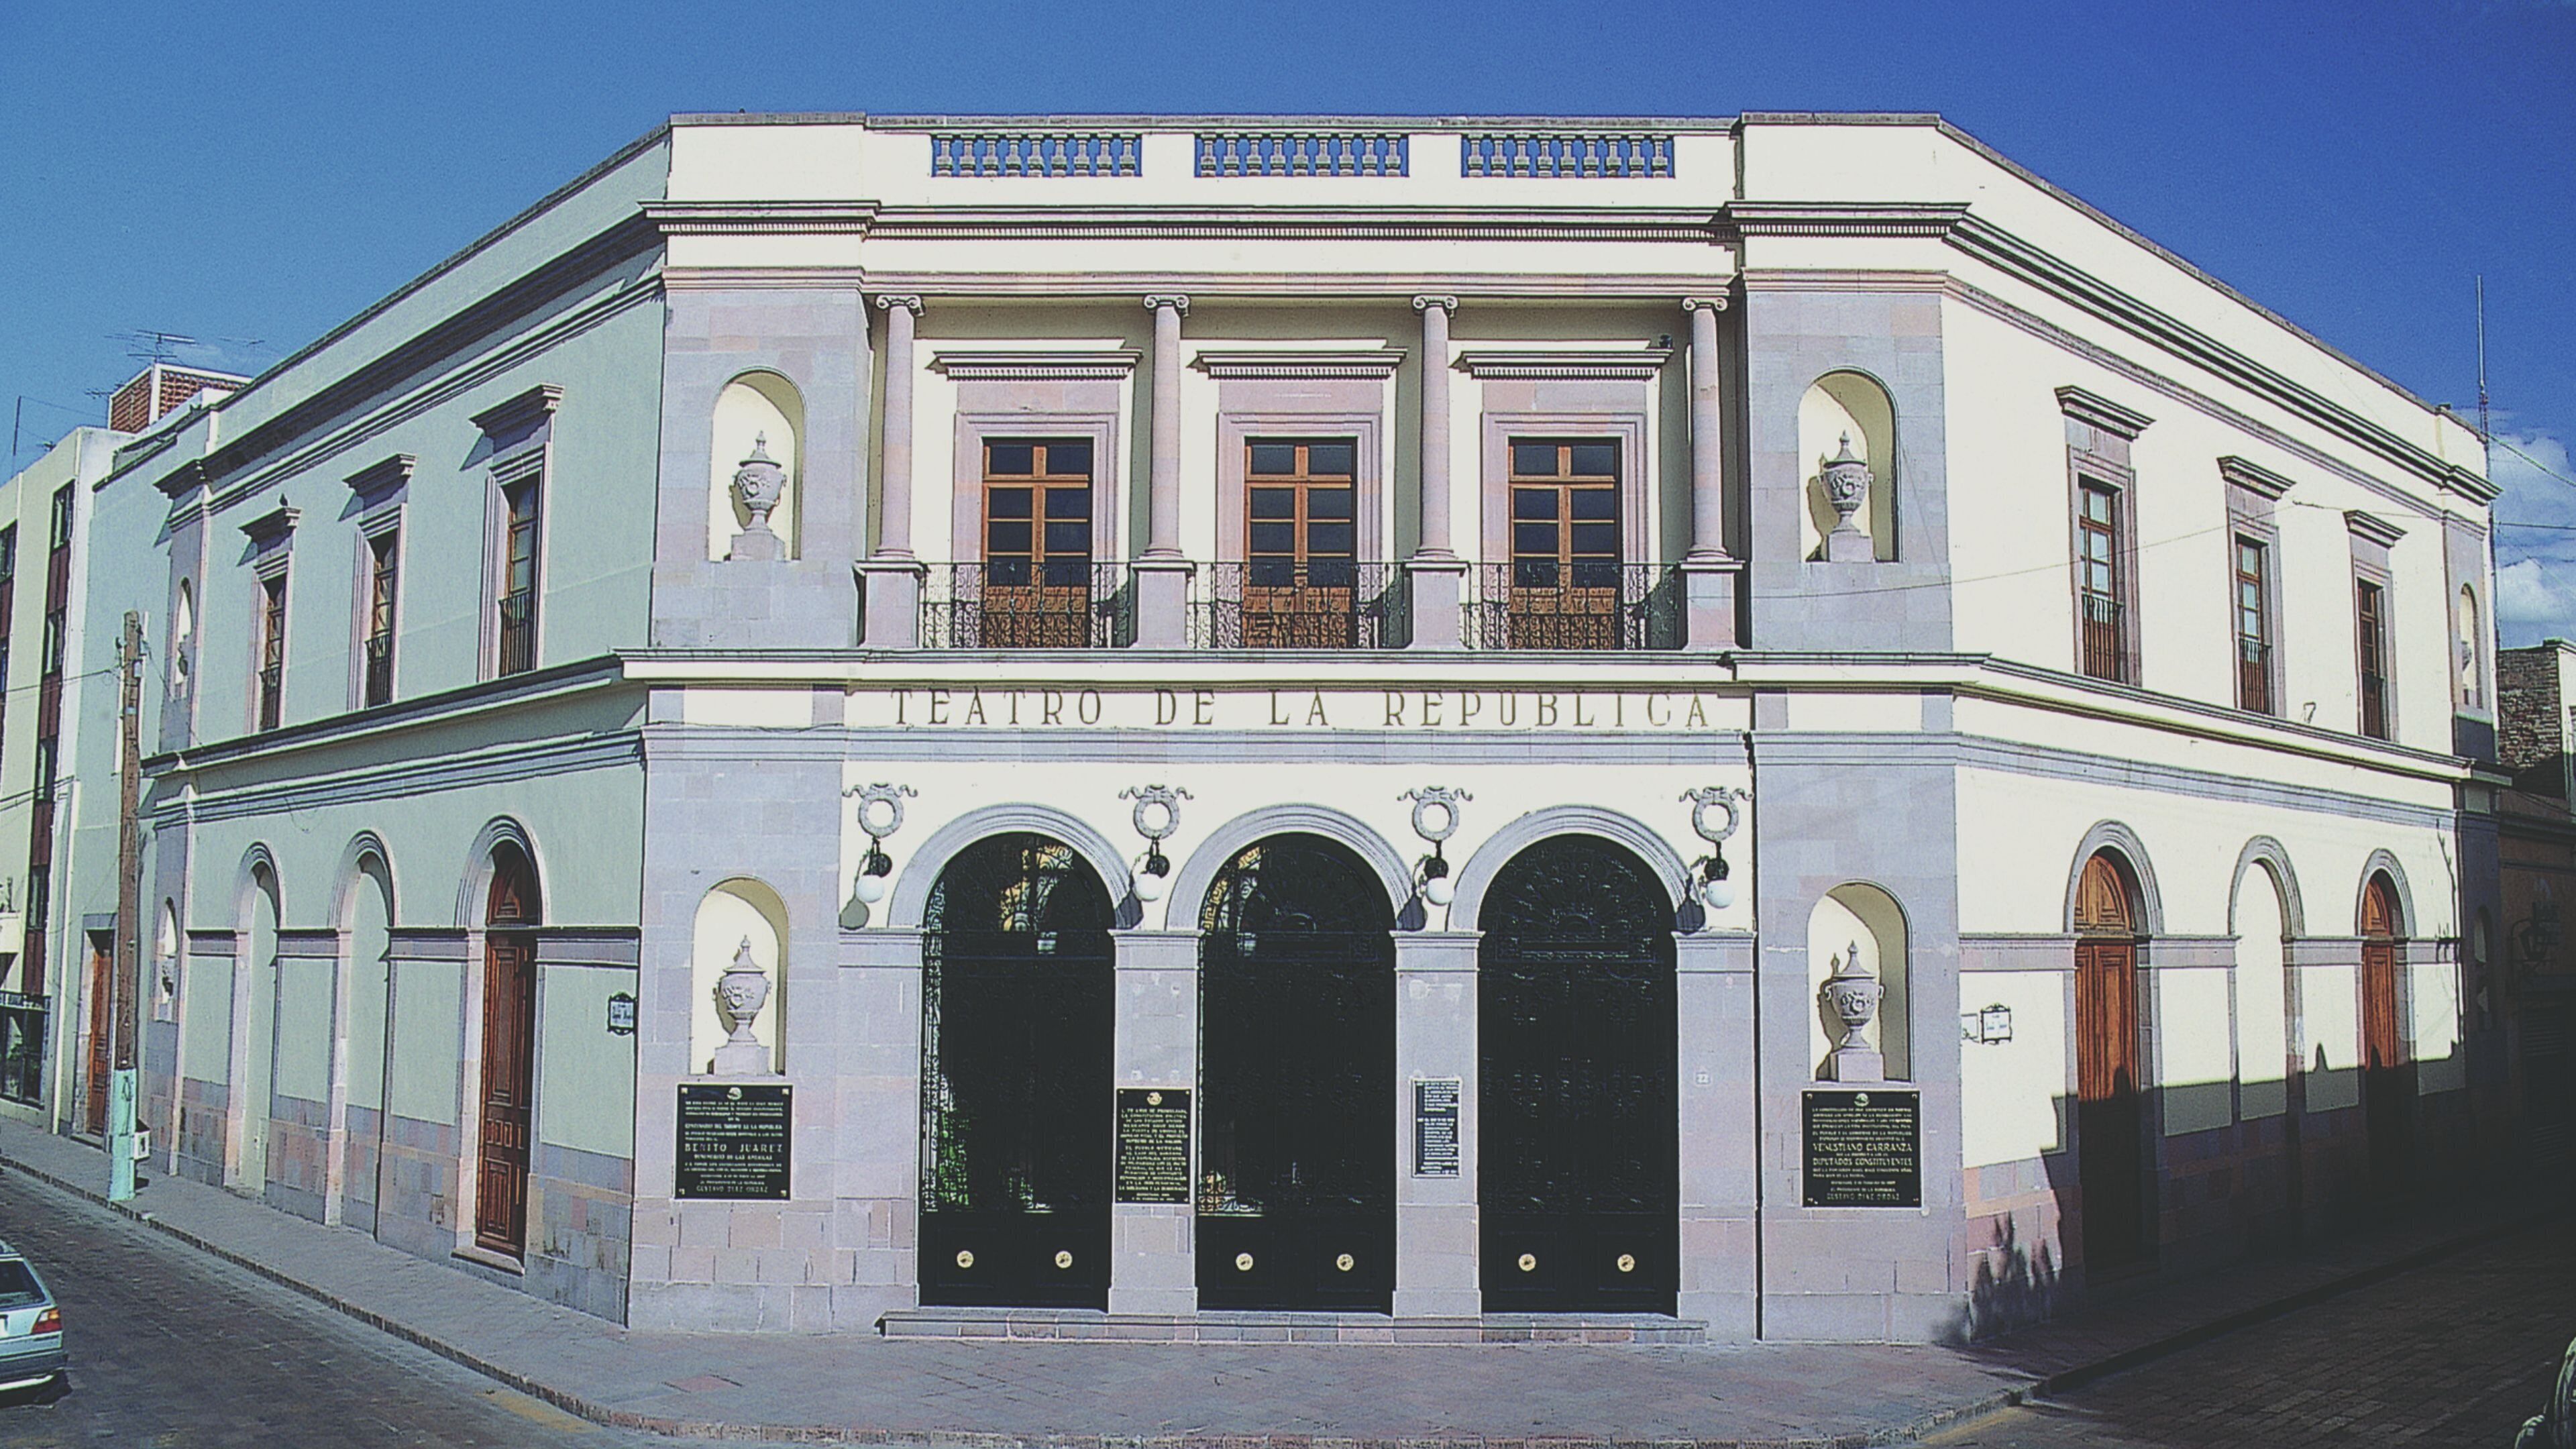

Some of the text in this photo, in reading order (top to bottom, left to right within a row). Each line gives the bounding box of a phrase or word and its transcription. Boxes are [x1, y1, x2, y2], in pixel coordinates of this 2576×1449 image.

[891, 688, 1709, 727] TEATRO DE LA REPUBLICA
[685, 1143, 727, 1152] BENITO
[1866, 1143, 1913, 1152] CARRANZA
